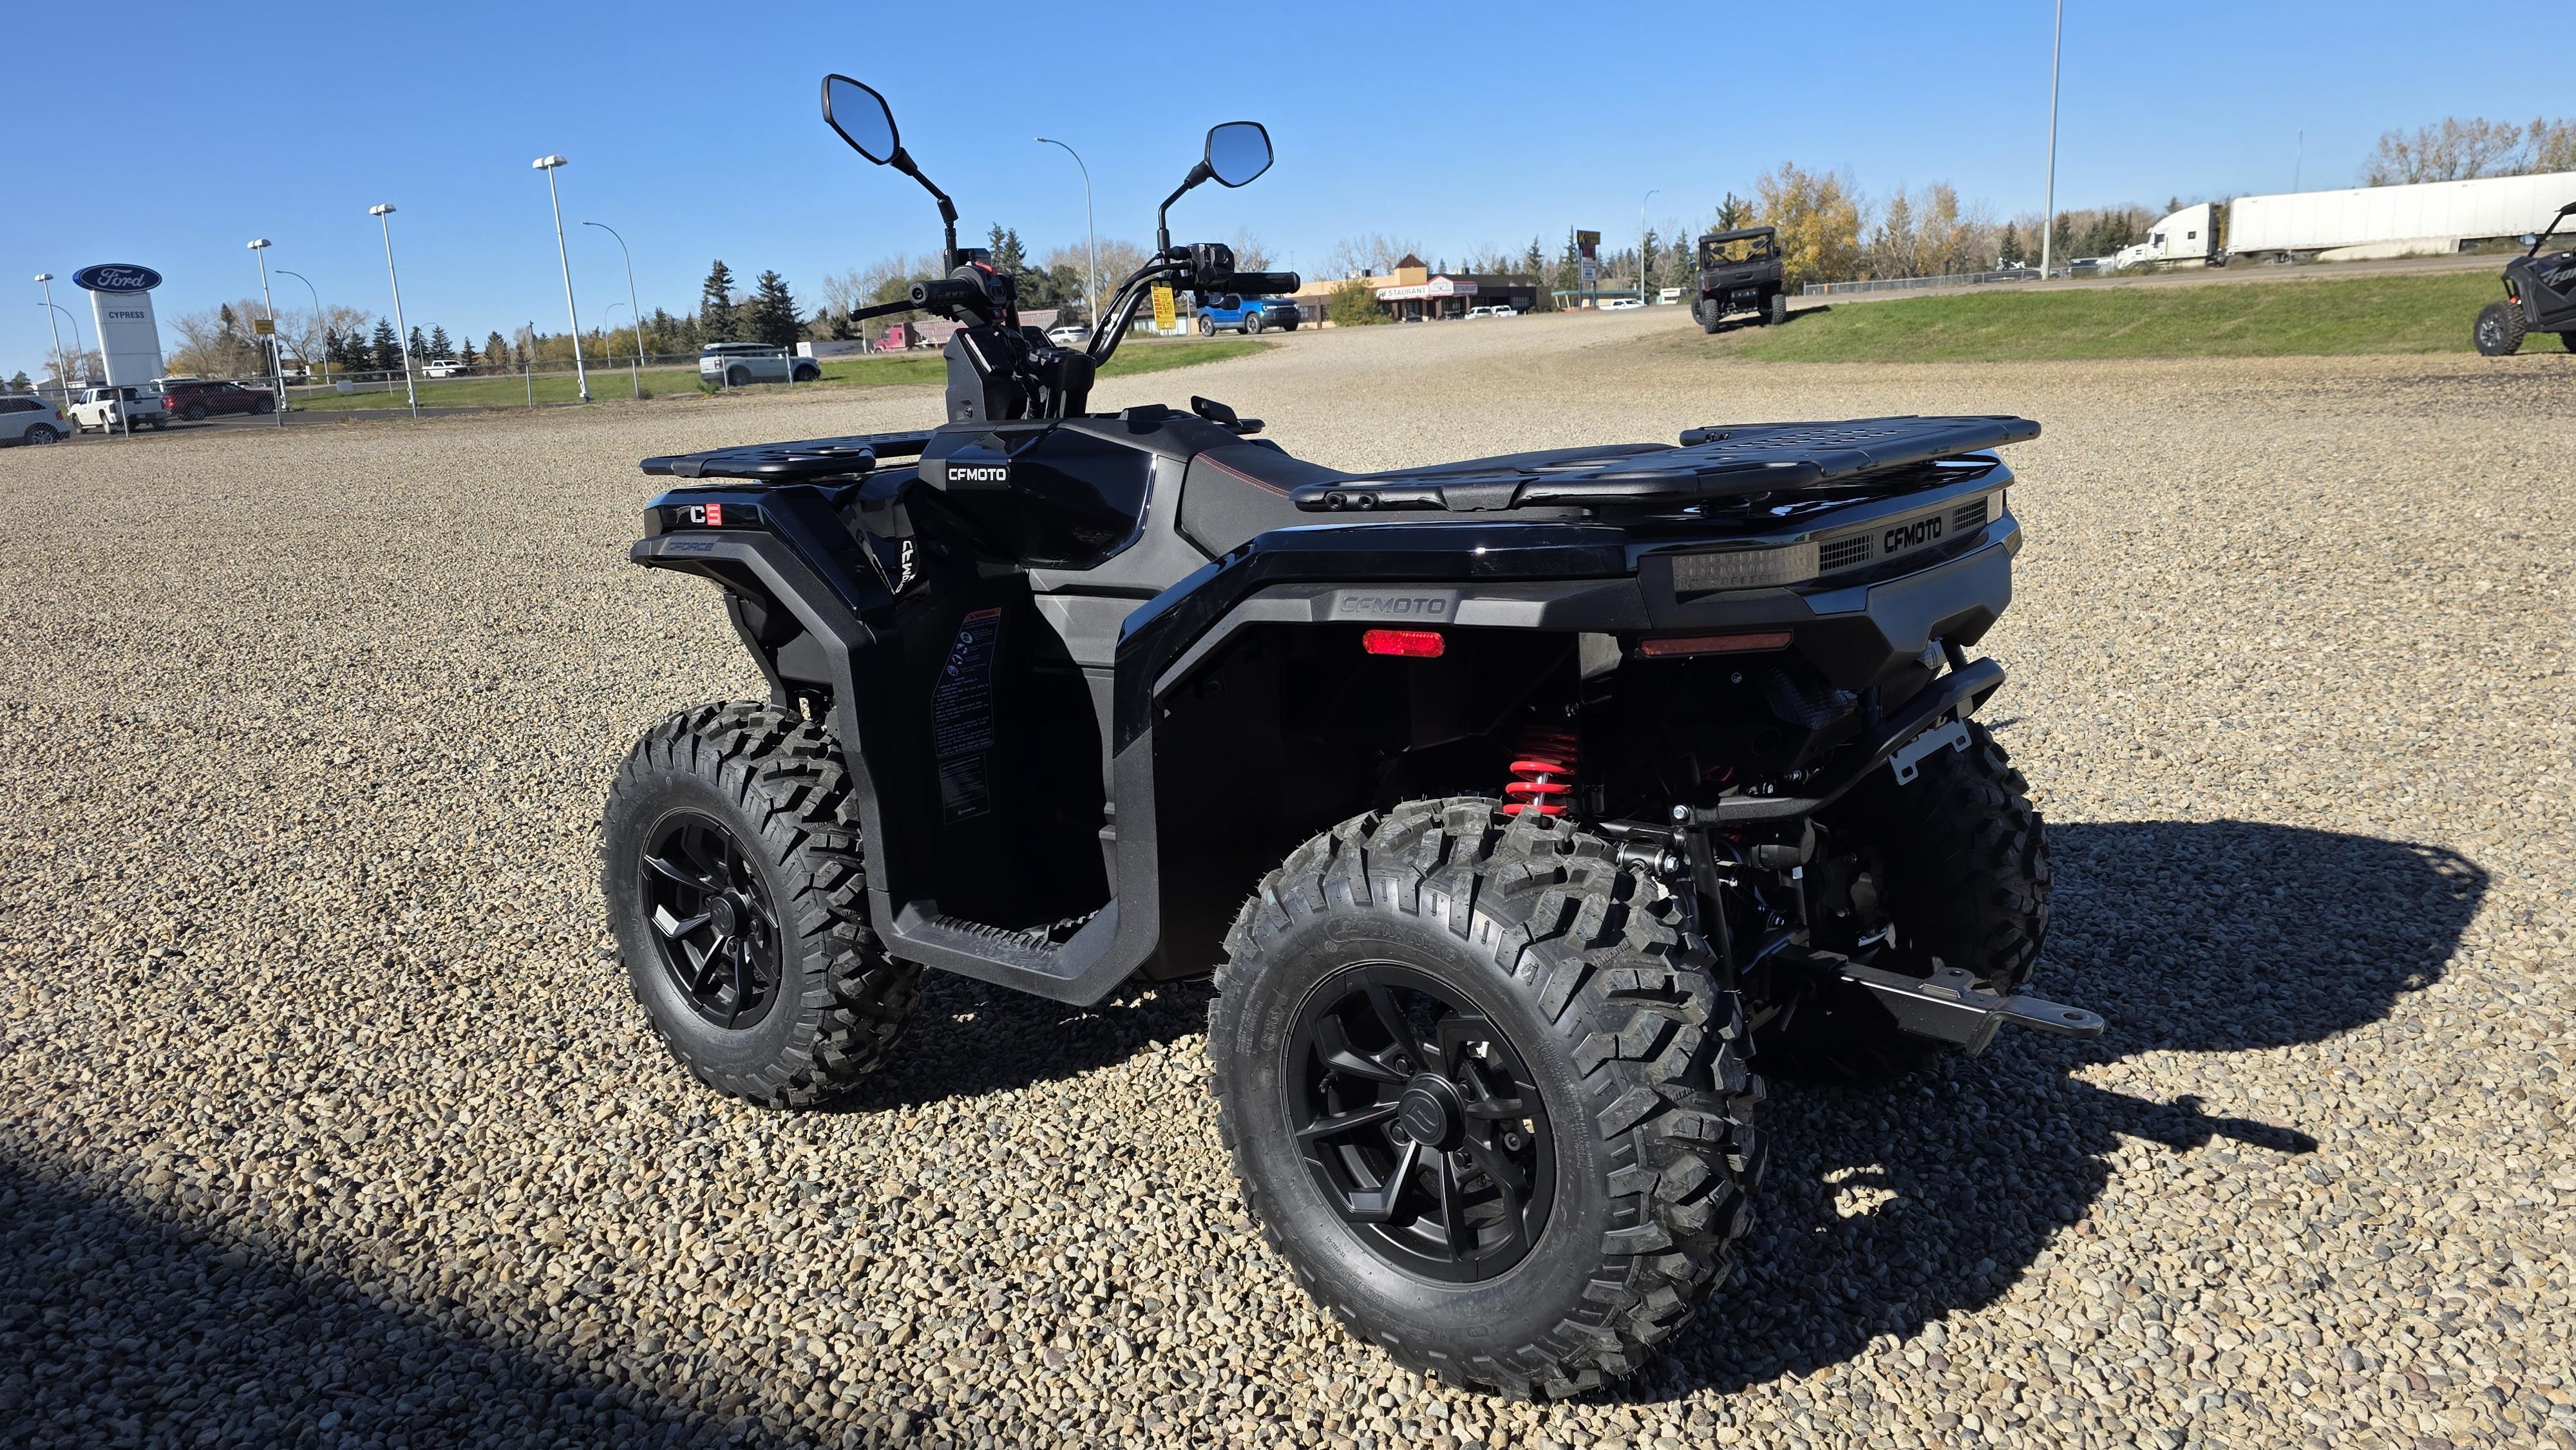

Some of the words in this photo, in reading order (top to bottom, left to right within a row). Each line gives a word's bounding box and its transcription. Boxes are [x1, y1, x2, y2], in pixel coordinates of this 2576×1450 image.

[97, 268, 146, 287] Ford
[109, 311, 145, 319] CYPRESS
[949, 467, 1007, 482] CFMOTO
[1884, 516, 1942, 554] CFMOTO
[1340, 596, 1446, 615] CFMOTO
